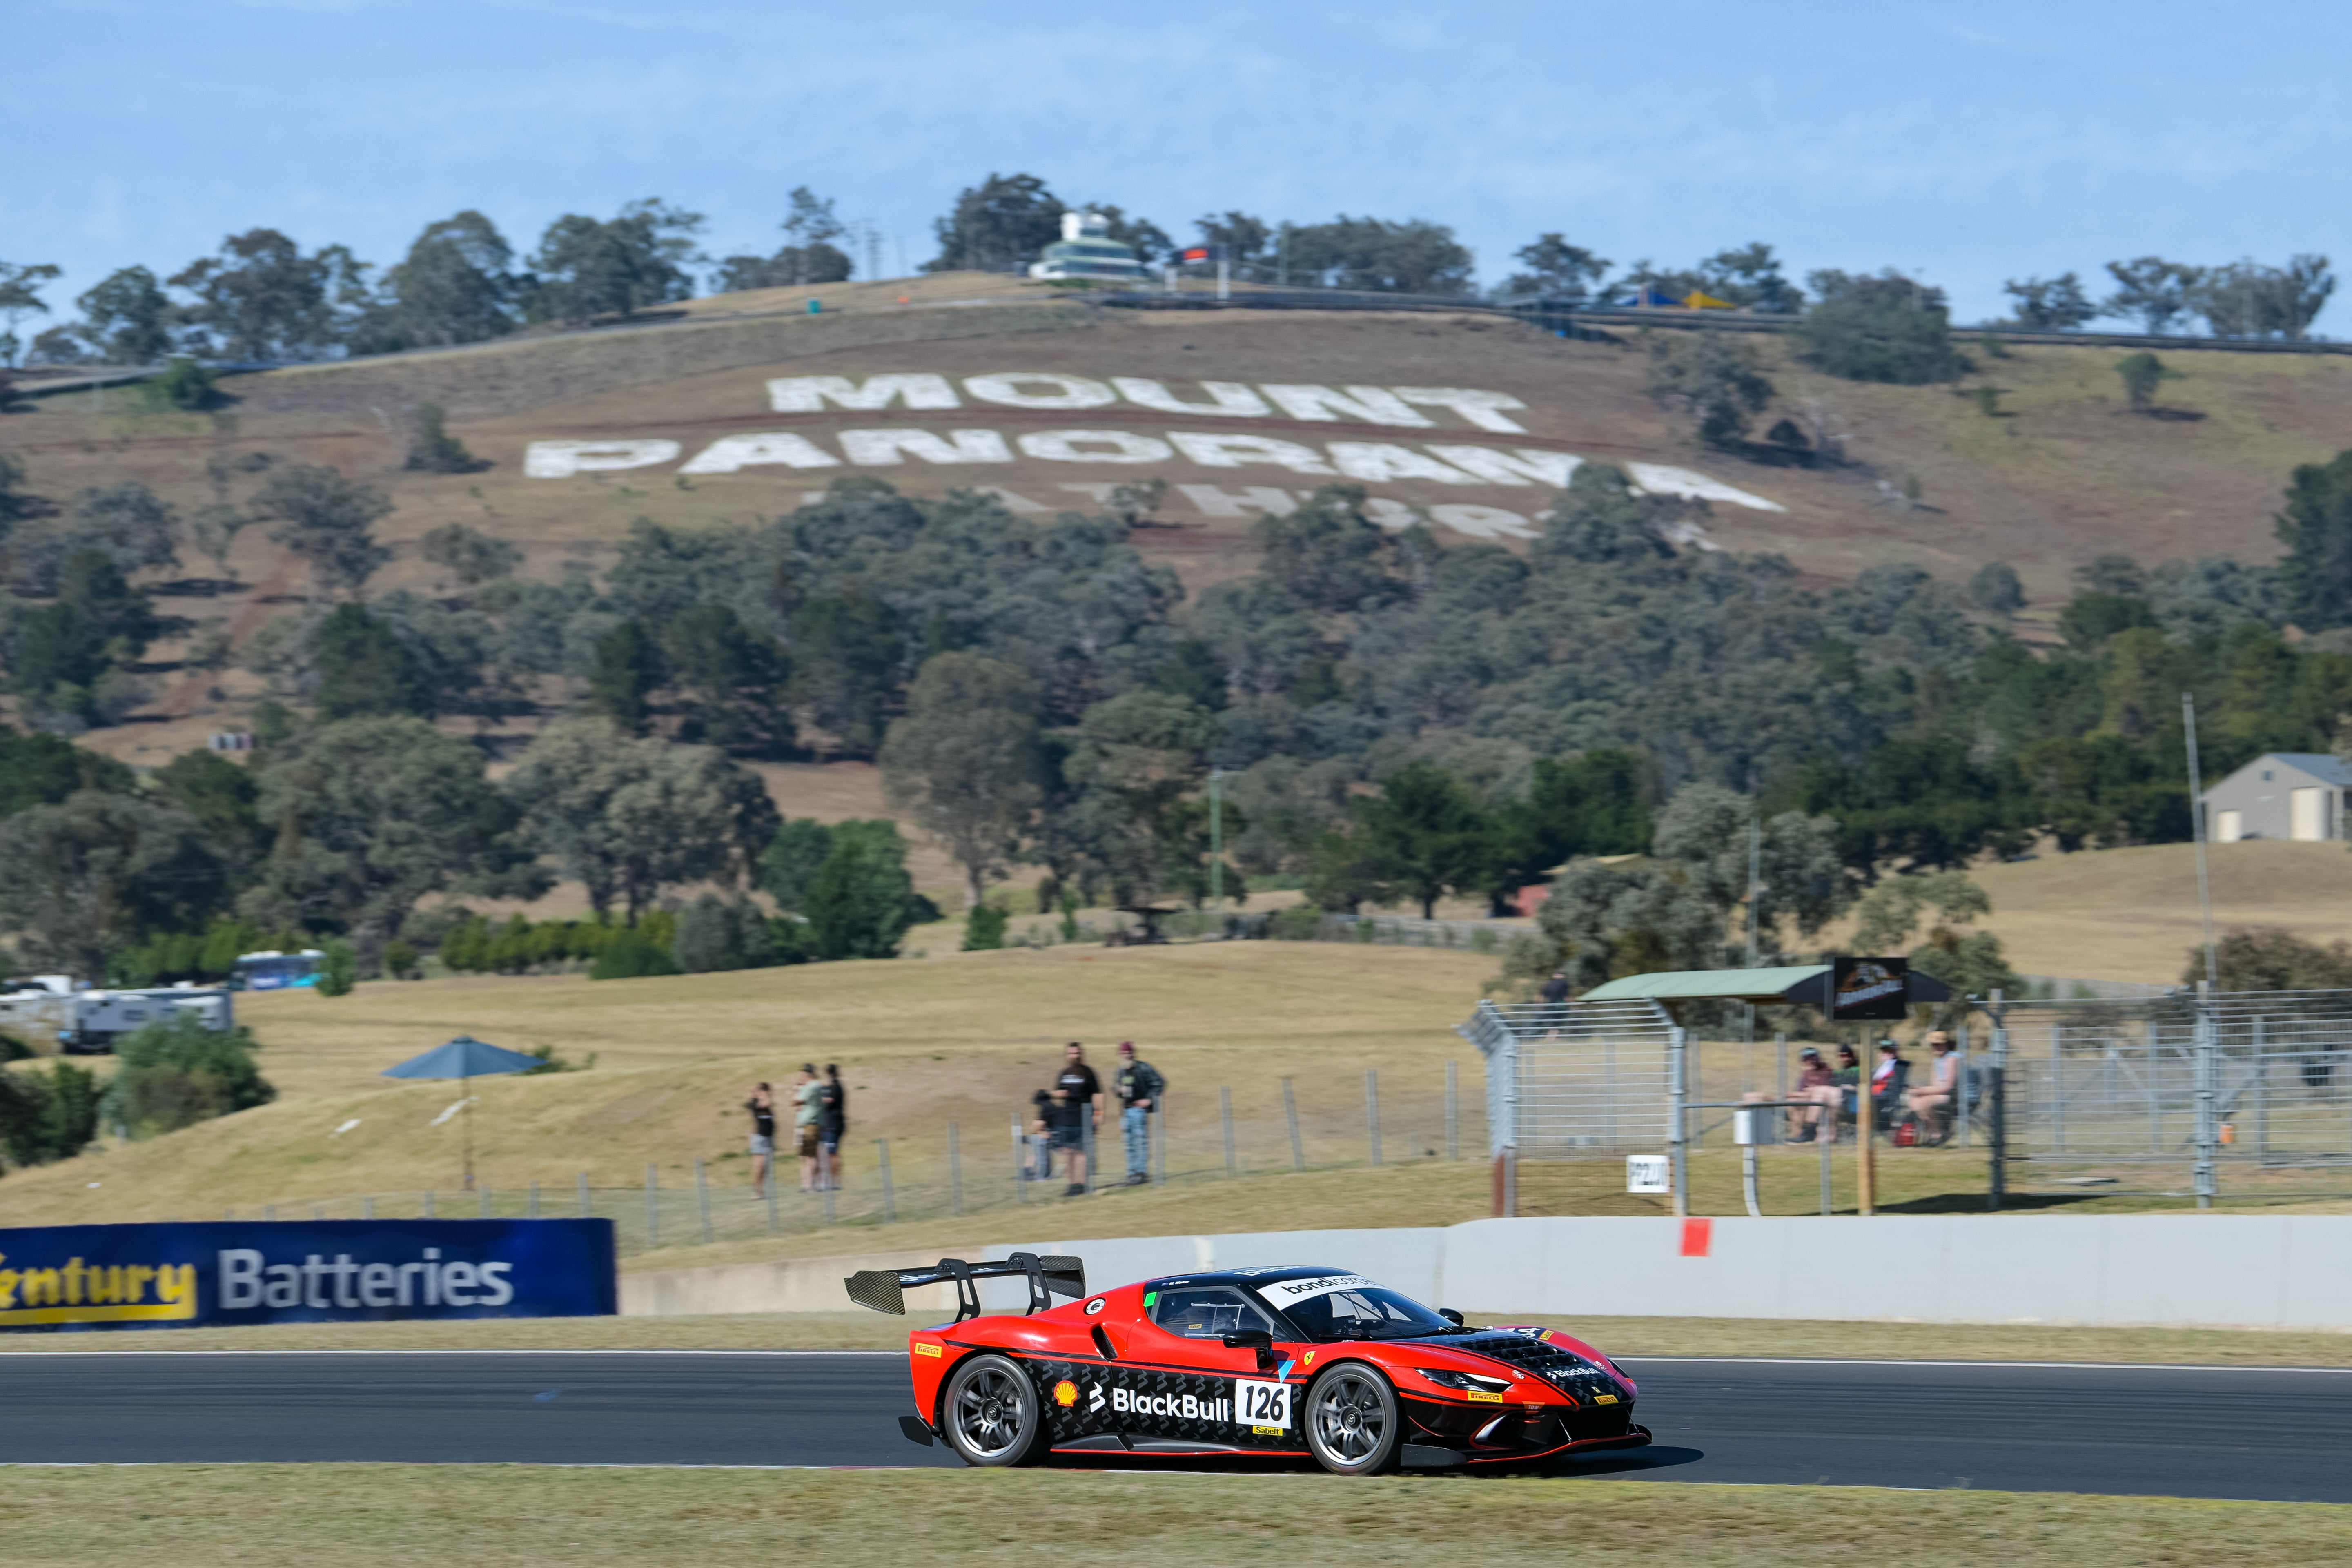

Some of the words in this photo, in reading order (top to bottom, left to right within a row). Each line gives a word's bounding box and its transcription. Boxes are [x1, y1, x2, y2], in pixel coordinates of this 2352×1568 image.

[766, 372, 1528, 434] MOUNT
[0, 1252, 198, 1322] entury
[218, 1247, 514, 1309] Batteries
[917, 1345, 939, 1355] PIRELLI
[1553, 1367, 1601, 1377] BlackBull
[1113, 1388, 1229, 1422] BlackBull
[1245, 1385, 1284, 1422] 126
[1471, 1392, 1499, 1401] PIRELLI
[1255, 1426, 1280, 1436] Sabelt
